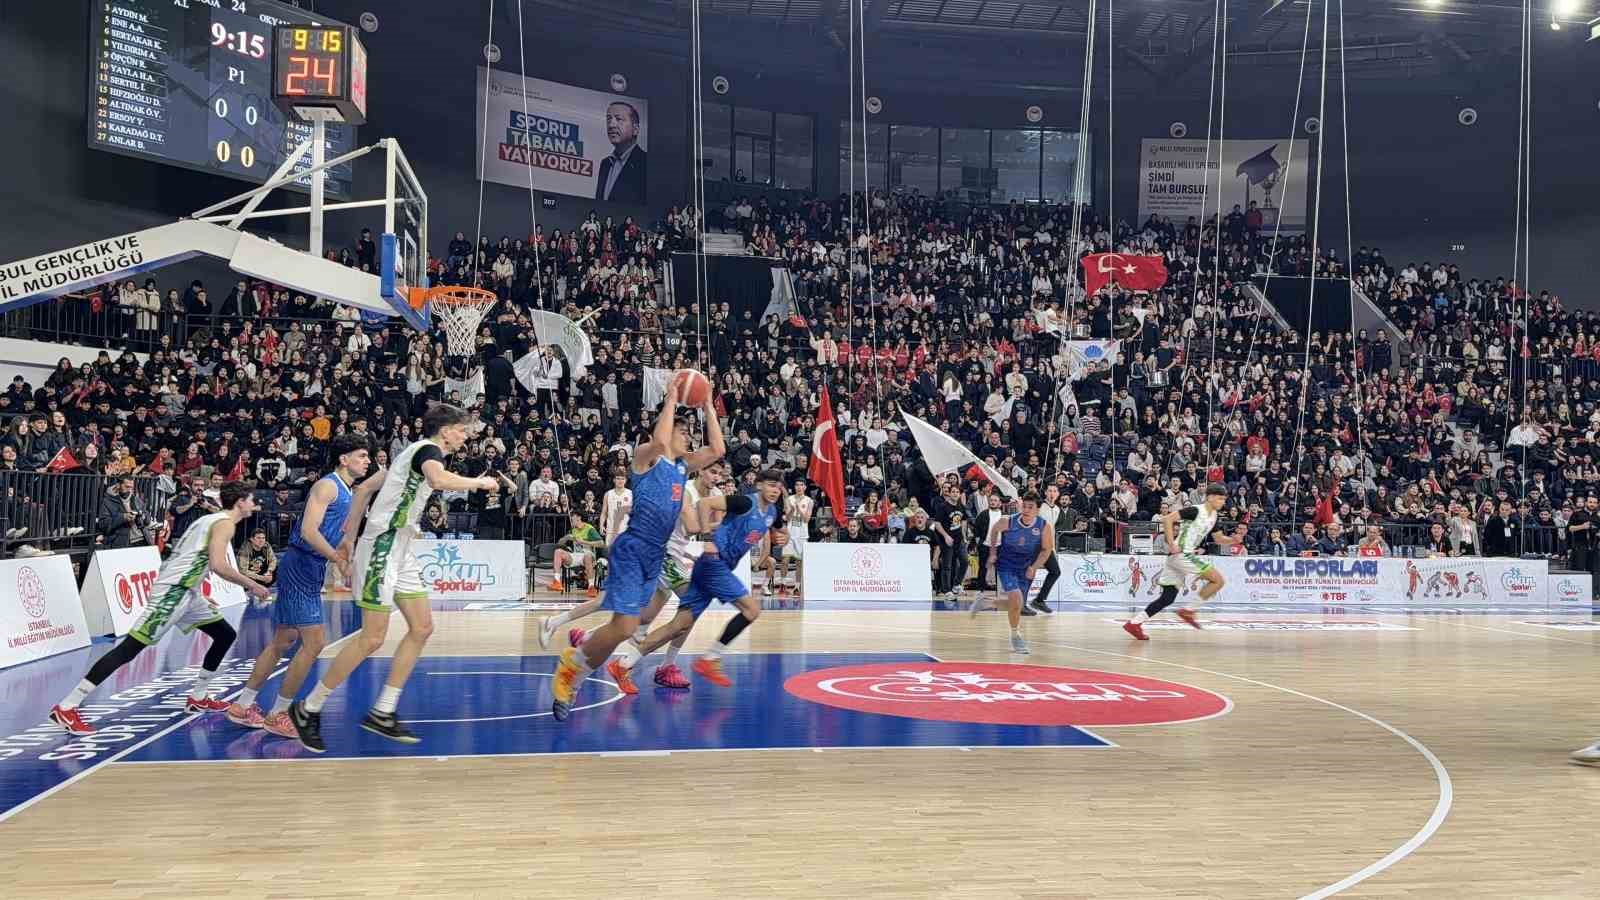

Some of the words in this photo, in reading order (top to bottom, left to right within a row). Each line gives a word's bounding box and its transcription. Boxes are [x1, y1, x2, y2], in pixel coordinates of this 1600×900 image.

[112, 6, 138, 19] AYDIN
[231, 0, 246, 13] 24
[211, 22, 265, 58] 9:15
[294, 29, 308, 50] 9
[322, 30, 342, 52] 15
[110, 64, 138, 78] YAYLA
[228, 66, 246, 85] P1
[286, 56, 335, 95] 24
[215, 98, 228, 118] 0
[245, 106, 258, 125] 0
[516, 113, 570, 138] SPORU
[217, 140, 230, 162] 0
[241, 146, 254, 168] 0
[511, 130, 578, 155] TABANA
[502, 144, 592, 175] YAYIYORUZ
[1148, 184, 1166, 194] TAM
[35, 242, 113, 272] GENÇLİK
[114, 236, 140, 251] VE
[24, 251, 144, 294] MÜDÜRLÜĞÜ
[422, 562, 496, 585] OKUL
[1245, 559, 1293, 577] OKUL
[1330, 592, 1348, 600] TBF
